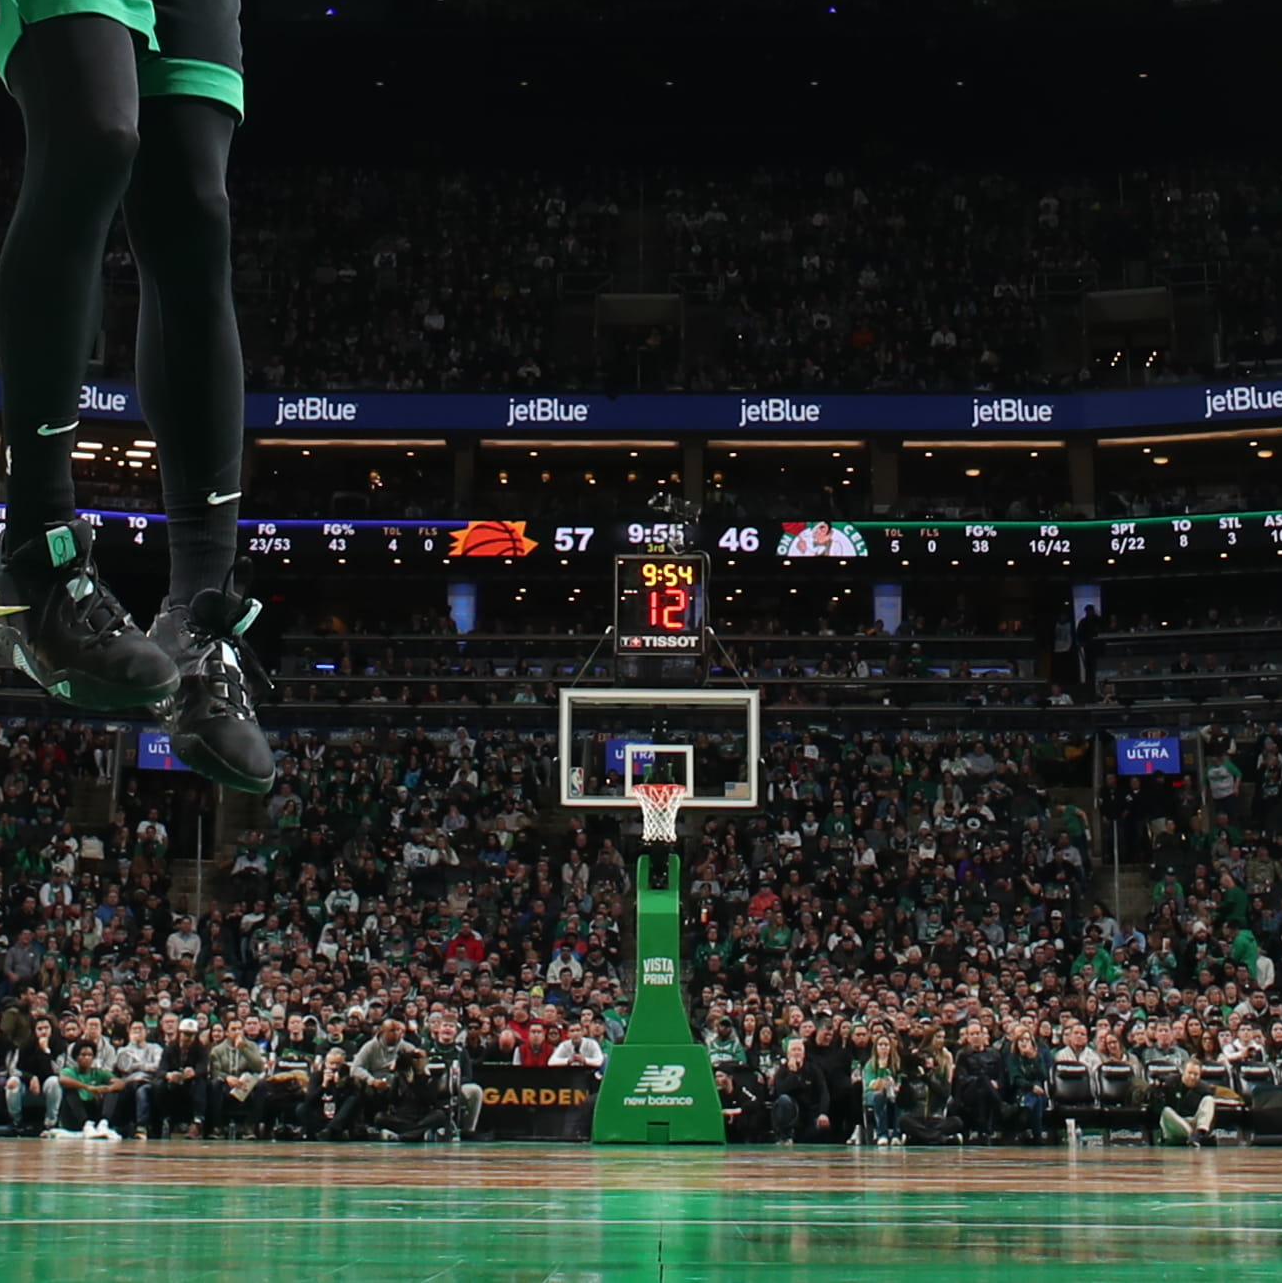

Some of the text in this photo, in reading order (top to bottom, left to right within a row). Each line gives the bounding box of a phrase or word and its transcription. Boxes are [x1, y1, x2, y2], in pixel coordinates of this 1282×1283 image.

[78, 385, 126, 412] Blue
[276, 397, 357, 424] jetBlue
[507, 397, 588, 426] jetBlue
[739, 397, 821, 426] jetBlue
[972, 398, 1053, 426] jetBlue
[127, 517, 438, 536] TO FG FG% TOL FLS
[885, 528, 903, 537] TOL
[921, 528, 939, 536] FLS
[966, 525, 996, 536] FG%
[1041, 525, 1058, 536] FG
[1110, 521, 1135, 535] 3PT
[1171, 518, 1191, 531] TO
[1220, 517, 1242, 529] STL
[135, 532, 433, 553] 4 23/53 43 4 0
[555, 528, 594, 551] 57
[647, 543, 665, 554] 3rd
[719, 528, 759, 551] 46
[891, 540, 899, 552] 5
[928, 540, 936, 552] 0
[973, 540, 989, 552] 38
[1030, 540, 1070, 555] 16/42
[1112, 537, 1144, 554] 6/22
[1180, 535, 1188, 547] 8
[1228, 532, 1236, 544] 3
[642, 565, 693, 586] 9:54
[649, 591, 685, 629] 12
[642, 636, 698, 648] TISSOT
[615, 748, 655, 760] UTRA
[1127, 748, 1169, 759] ULTRA
[643, 957, 674, 973] VISTA
[643, 973, 674, 985] PRINT
[482, 1088, 589, 1106] GARDEN
[624, 1095, 693, 1106] new balance
